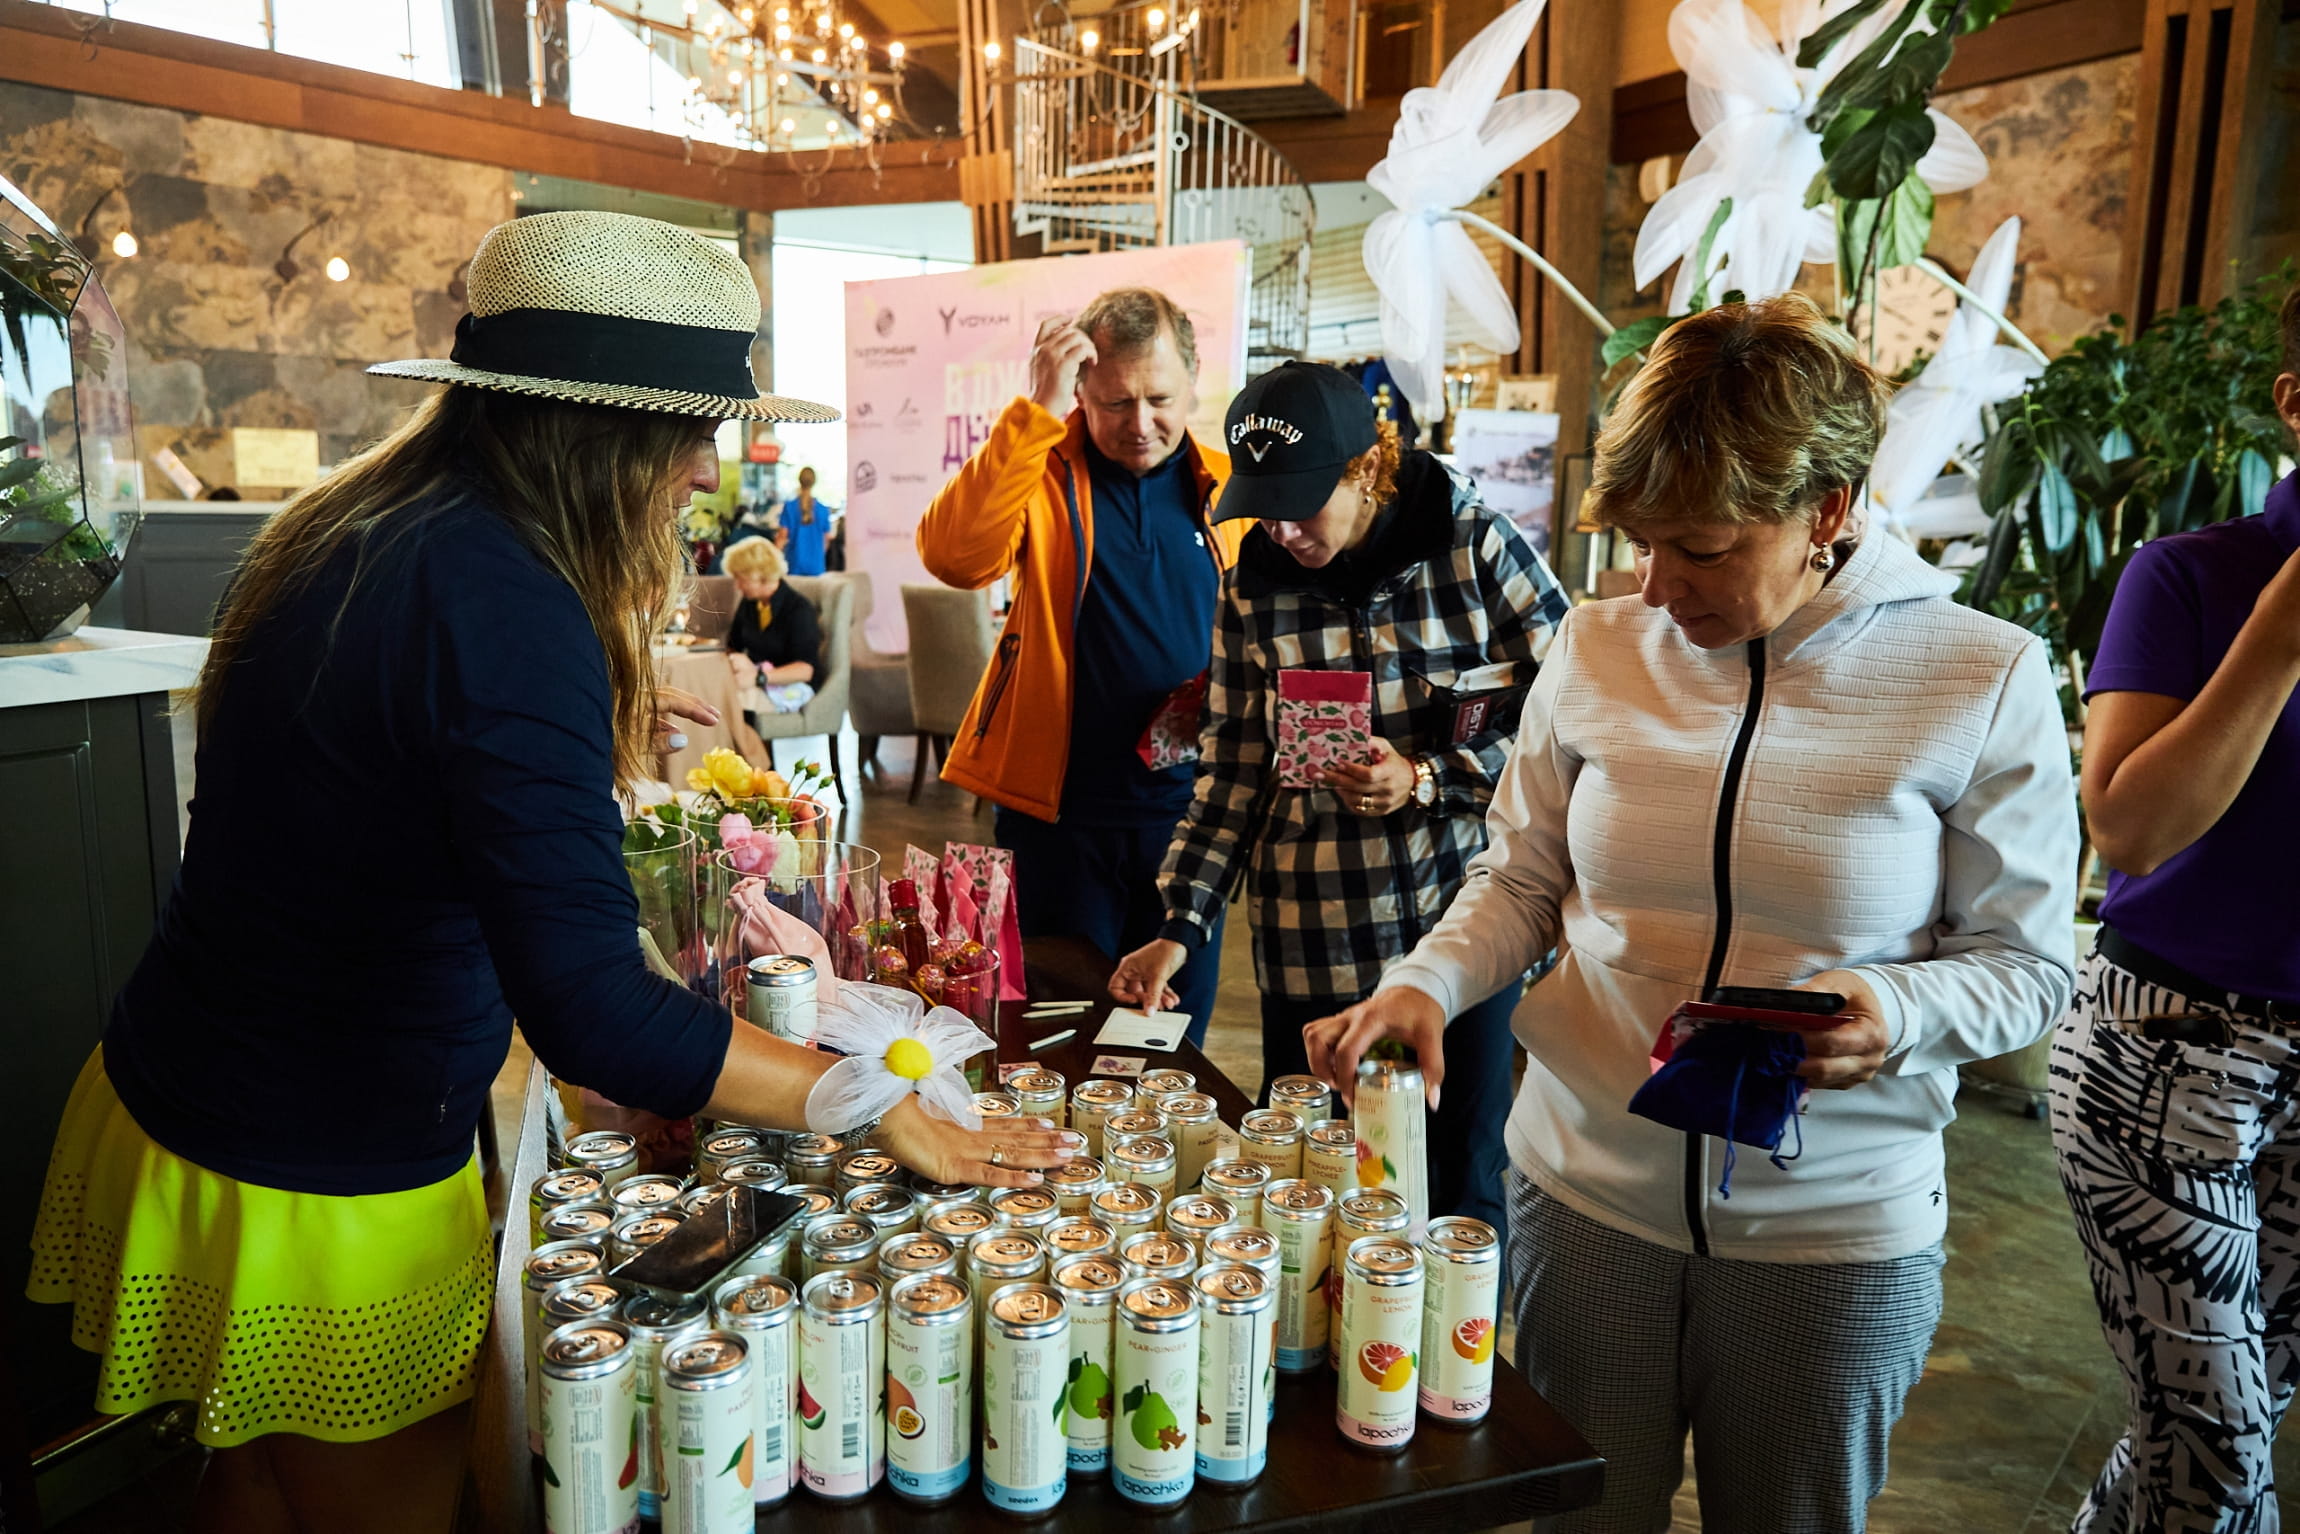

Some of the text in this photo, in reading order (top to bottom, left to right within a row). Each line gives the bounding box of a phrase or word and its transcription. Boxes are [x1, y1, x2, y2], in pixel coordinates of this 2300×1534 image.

[1230, 413, 1304, 445] Callaway
[1466, 702, 1485, 741] DISTA
[1383, 1304, 1412, 1314] LEMON
[1121, 1474, 1184, 1496] lapochka
